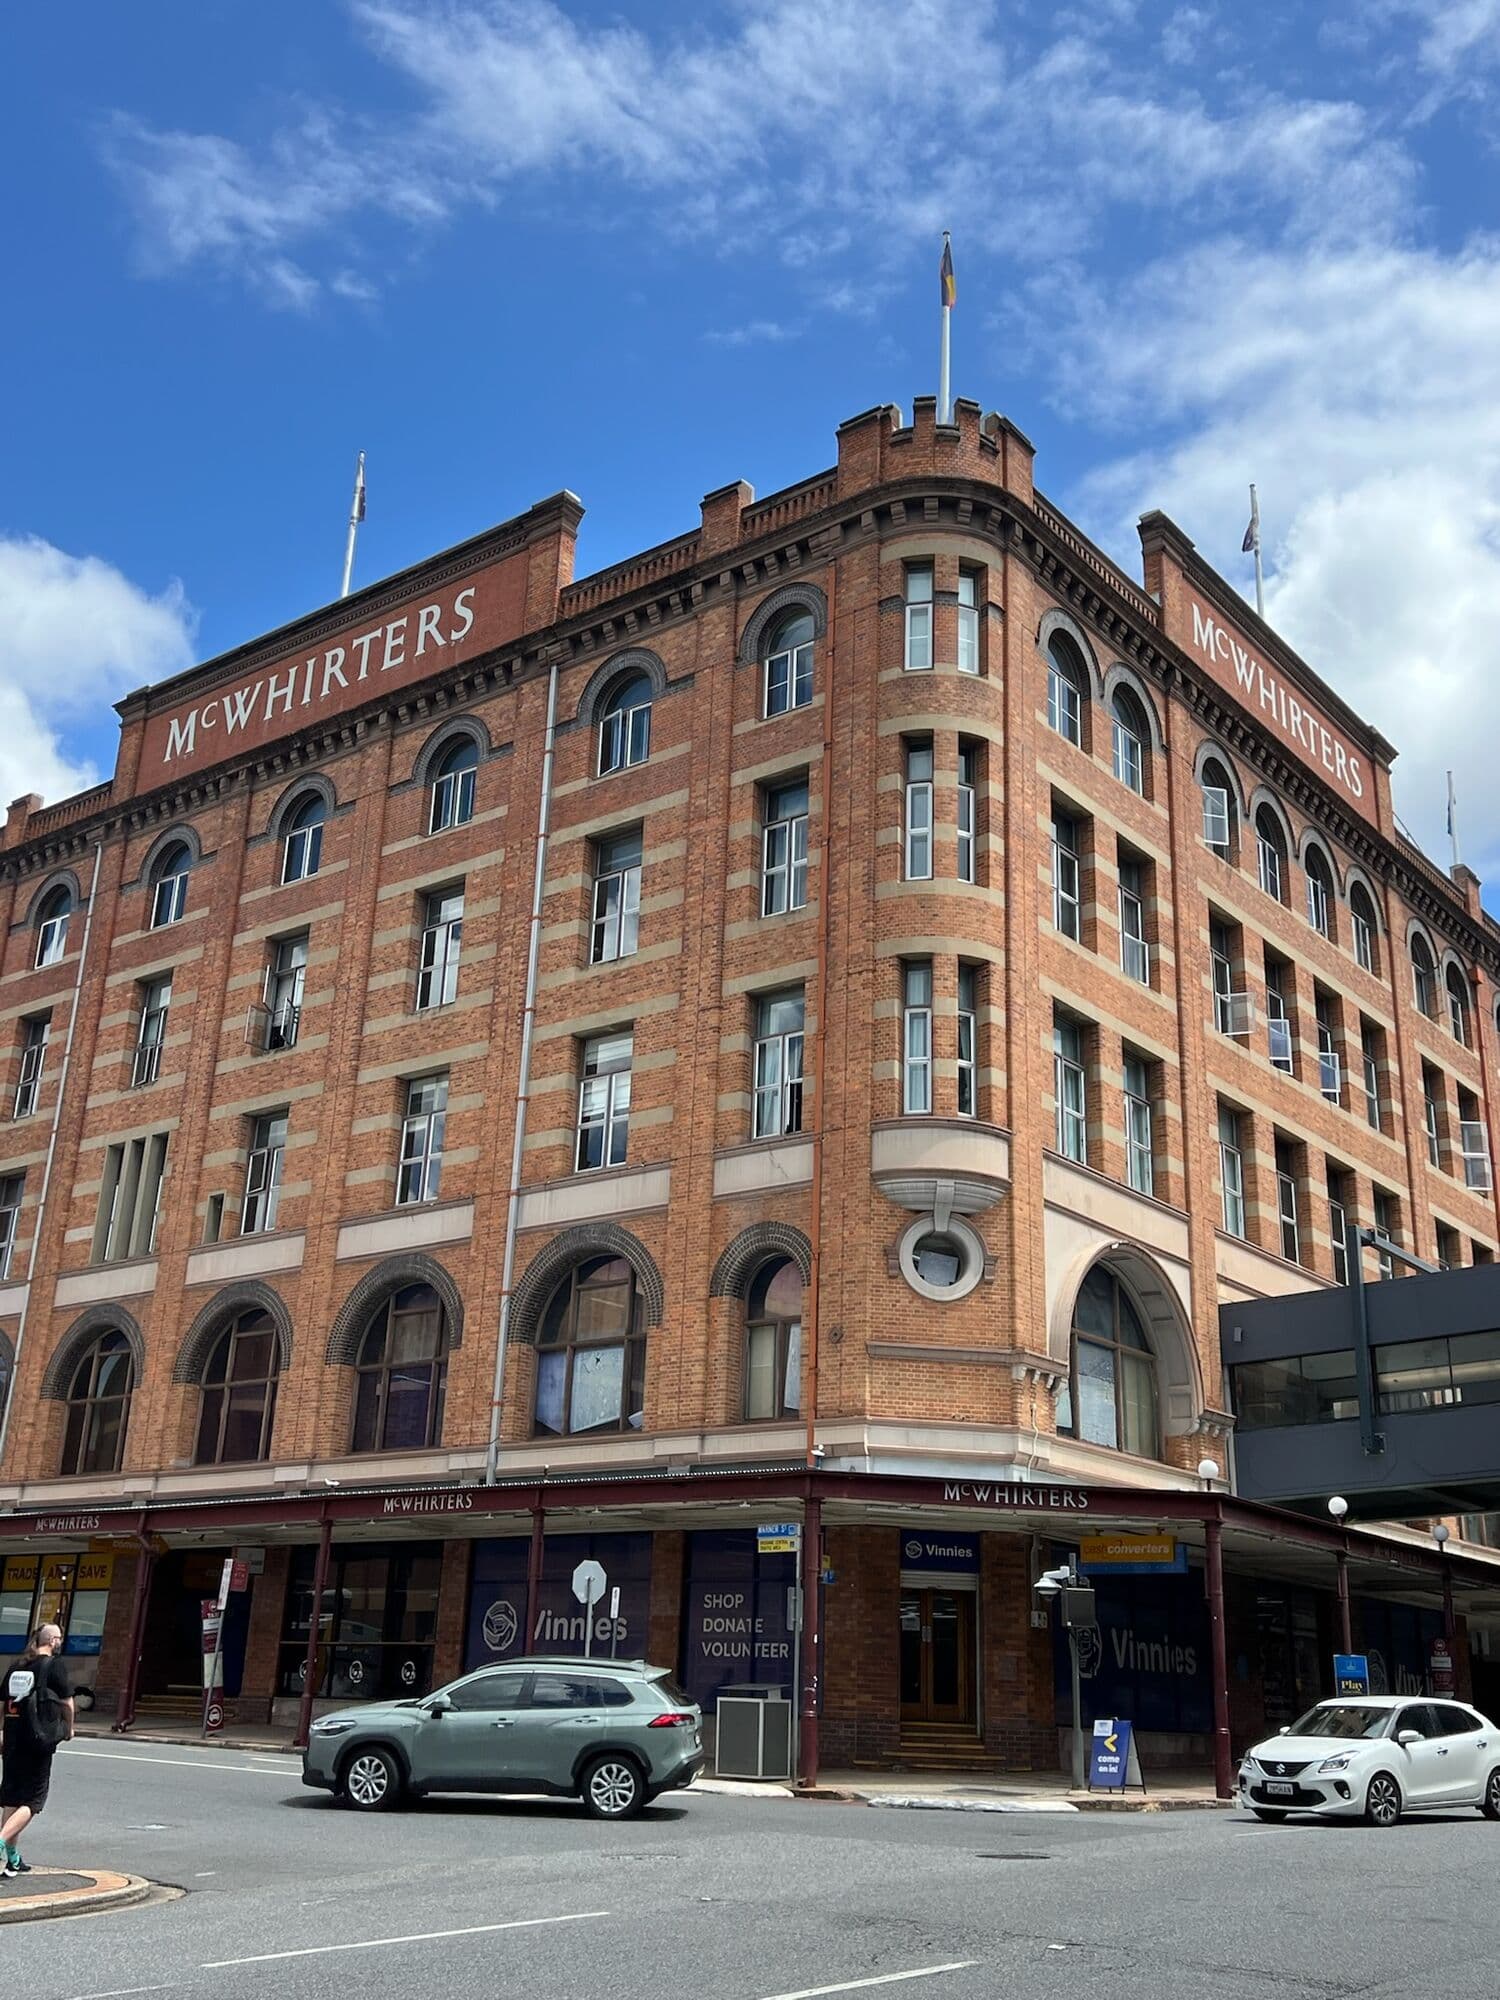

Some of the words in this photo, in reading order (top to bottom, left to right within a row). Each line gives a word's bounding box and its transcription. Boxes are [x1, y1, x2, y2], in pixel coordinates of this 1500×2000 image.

[926, 1544, 973, 1558] Vinnies
[1106, 1543, 1169, 1554] converters
[79, 1564, 107, 1579] SAVE
[703, 1593, 744, 1609] SHOP
[534, 1609, 627, 1641] innes
[703, 1617, 764, 1633] DONATE
[702, 1642, 789, 1658] VOLUNTEER
[1111, 1627, 1197, 1675] Vinnies
[1341, 1679, 1363, 1693] Play
[1097, 1755, 1120, 1763] come
[1098, 1765, 1108, 1773] on
